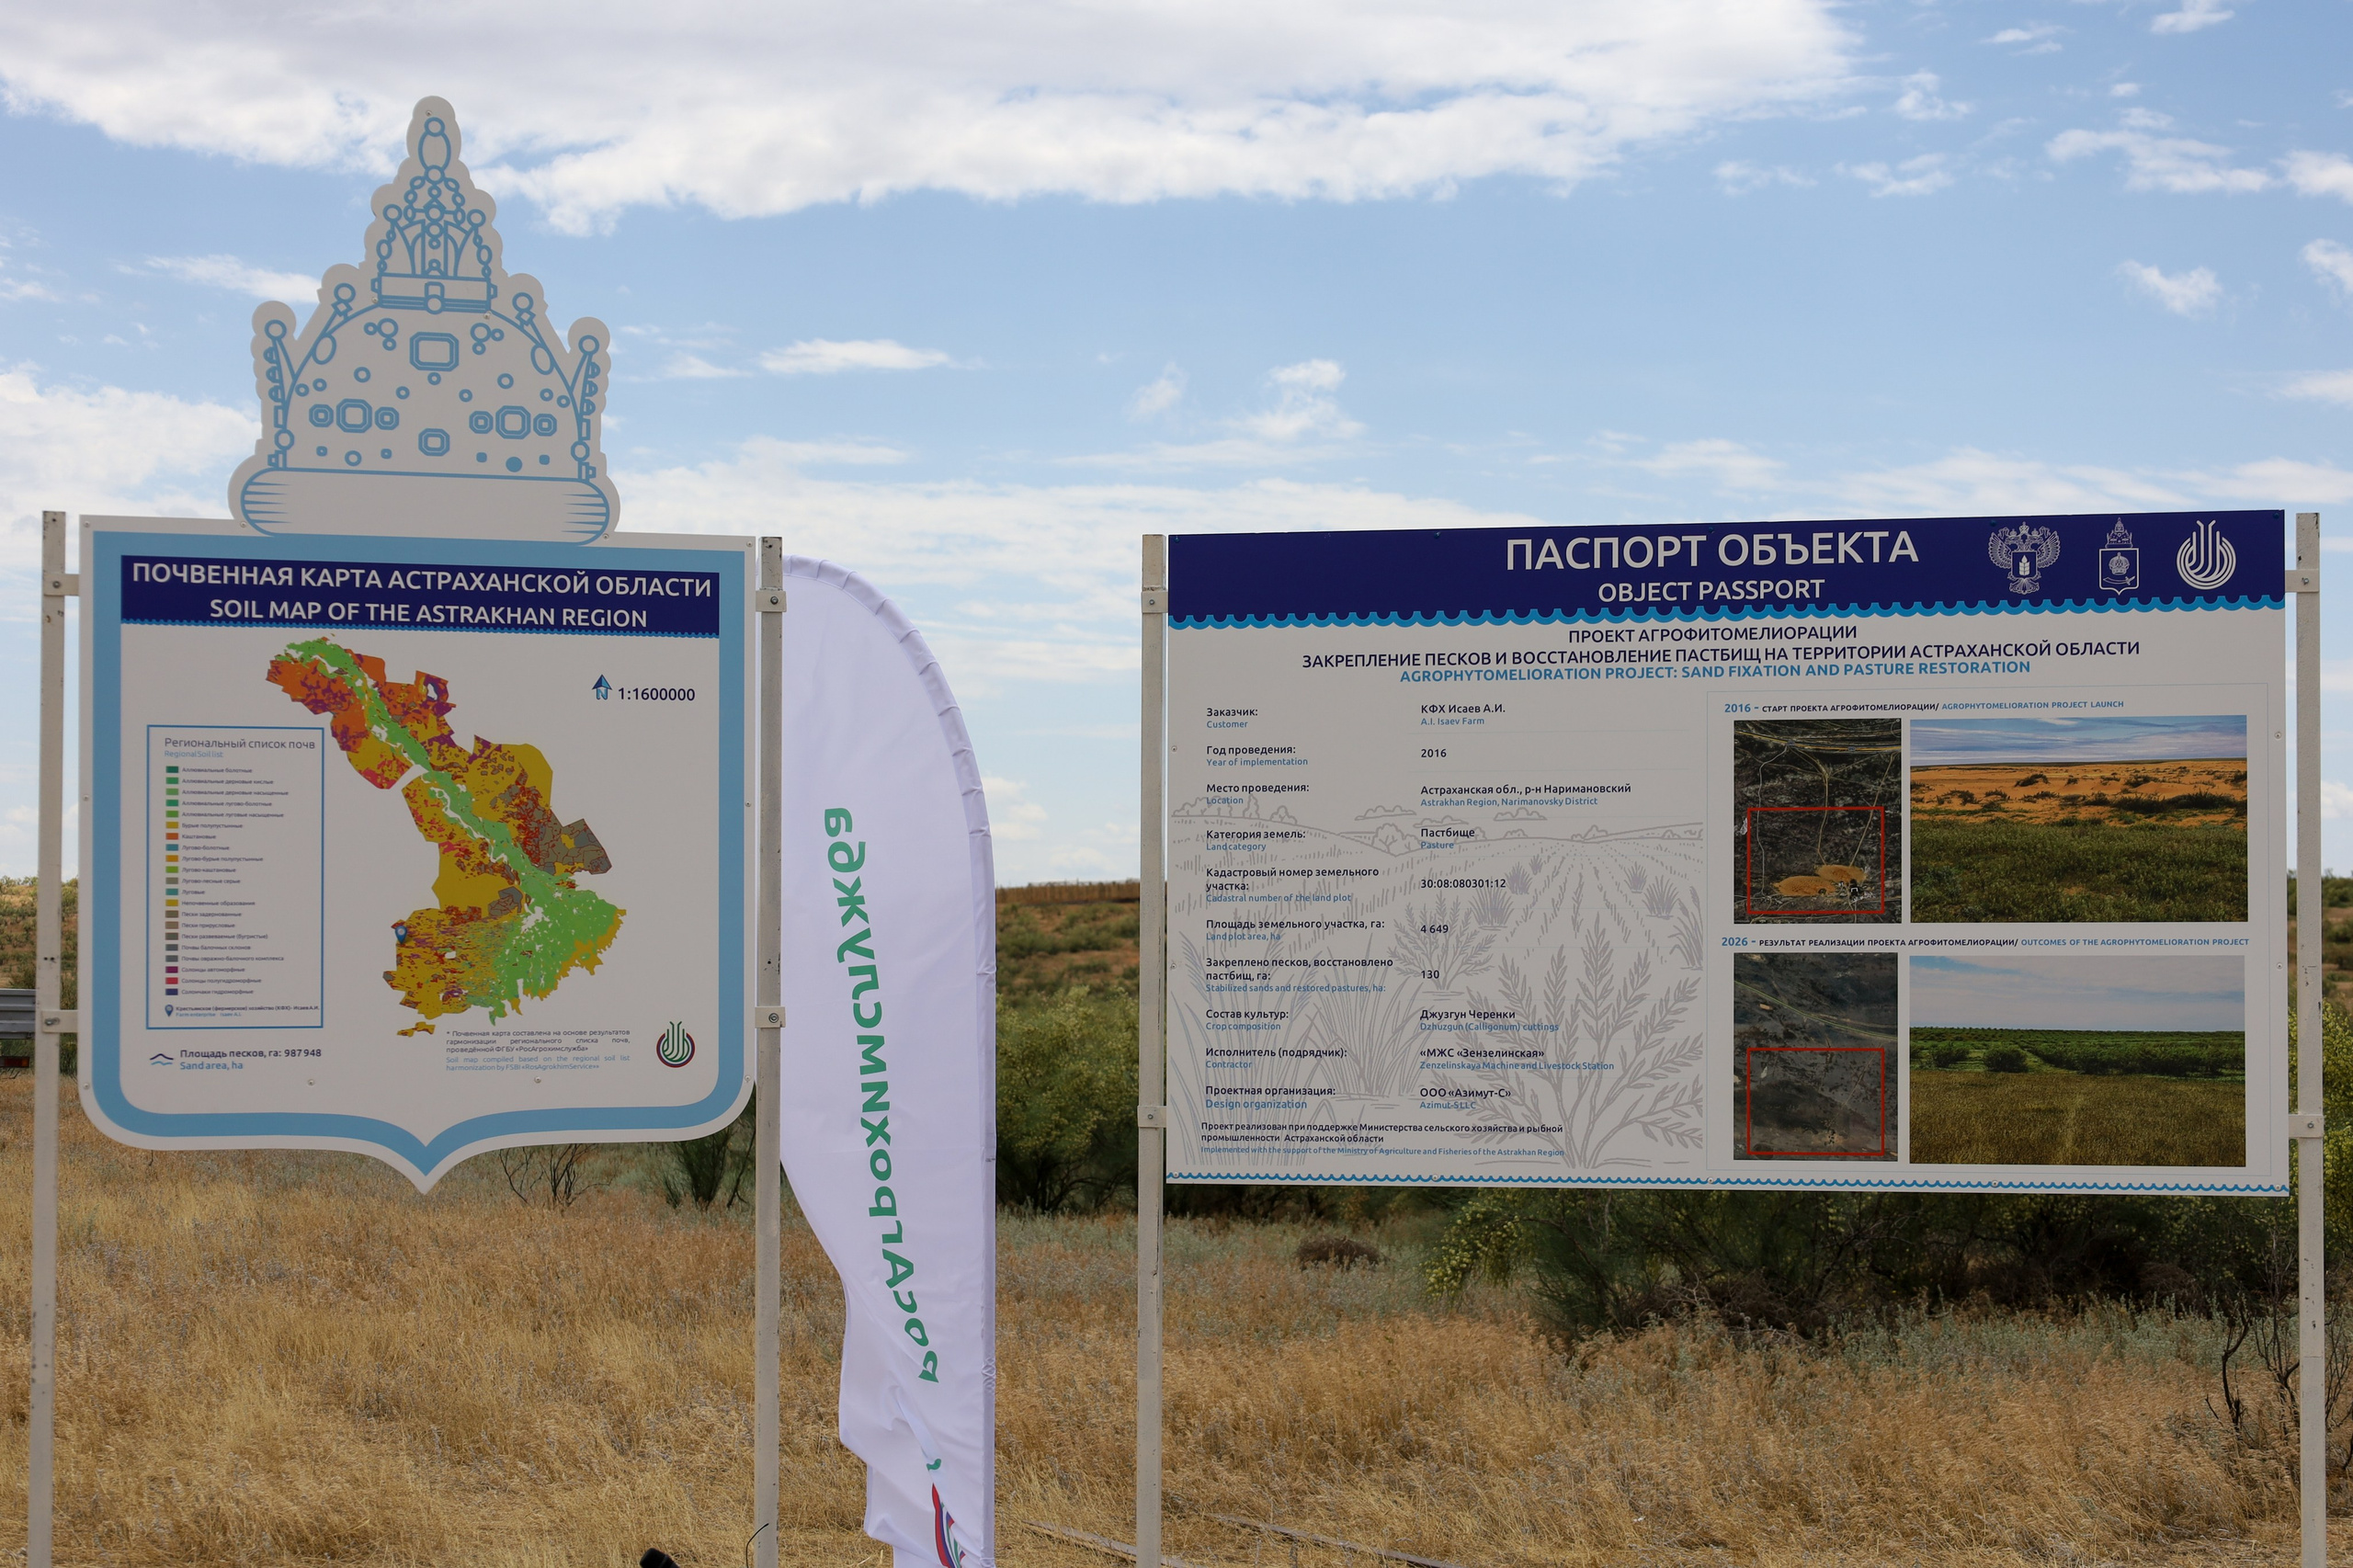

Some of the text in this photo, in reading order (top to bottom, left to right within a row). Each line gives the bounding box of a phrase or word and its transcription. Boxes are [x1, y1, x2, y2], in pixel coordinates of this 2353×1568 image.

[1507, 530, 1919, 571] ПАСПОРТ ОБЪЕКТА
[133, 562, 710, 597] ПОЧВЕННАЯ КАРТА АСТРАХАНСКОЙ ОБЛАСТИ
[1598, 579, 1825, 603] OBJECT PASSPORT
[210, 599, 647, 628] SOIL MAP OF THE ASTRAKHAN REGION
[1569, 625, 1857, 643] ПРОЕКТ АГРОФИТОМЕЛИОРАЦИИ
[1302, 640, 2140, 668] ЗАКРЕПЛЕНИЕ ПЕСКОВ И ВОССТАНОВЛЕНИЕ ПАСТБИЩ НА ТЕРРИТОРИИ АСТРАХАНСКОЙ ОБЛАСТИ
[1400, 661, 2030, 683] AGROPHYTOMELIORATION PROJECT: SAND FIXATION AND PASTURE RESTORATION
[619, 687, 696, 701] 1:1600000
[1421, 703, 1506, 714] КФХ Исаев А.И.
[1724, 703, 1751, 713] 2016
[1762, 705, 1788, 713] СТАРТ
[1830, 703, 1939, 711] АГРОФИТОМЕЛИОРАЦИИ/
[1941, 701, 2049, 711] AGROPHYTOMELIORATION
[2090, 700, 2124, 709] LAUNCH
[1206, 708, 1258, 717] Заказчик:
[1206, 720, 1248, 729] Customer
[1420, 717, 1485, 726] A.I. Isaev Farm
[165, 737, 315, 749] Региональный список почв
[164, 750, 198, 759] Regional
[197, 750, 211, 758] Soil
[1207, 745, 1296, 756] Год проведения:
[1421, 748, 1447, 758] 2016
[1206, 757, 1309, 767] Year of implementation
[1206, 784, 1310, 795] Место проведения:
[1420, 783, 1631, 797] Астраханская обл., р-н Наримановский
[1206, 796, 1244, 805] Location
[1420, 797, 1598, 808] Astrakhan Region, Narimanovsky District
[1206, 830, 1306, 841] Категория земель:
[1421, 827, 1475, 839] Пастбище
[1206, 842, 1267, 852] Land category
[1420, 841, 1455, 849] Pasture
[1206, 867, 1380, 879] Кадастровый номер земельного
[1206, 882, 1249, 893] участка:
[1421, 879, 1506, 889] 30:08:080301:12
[1206, 919, 1256, 930] Площадь
[1258, 921, 1323, 929] земельного
[1324, 921, 1368, 930] участка,
[1420, 924, 1449, 934] 4 649
[1206, 931, 1281, 943] Land plot area, ha
[1722, 937, 1748, 947] 2026
[1809, 939, 1865, 948] РЕАЛИЗАЦИИ
[1908, 938, 2018, 948] АГРОФИТОМЕЛИОРАЦИИ/
[1206, 958, 1269, 969] Закреплено
[1271, 960, 1312, 969] песков,
[1206, 971, 1271, 982] пастбищ, га:
[1421, 970, 1440, 980] 130
[1206, 1009, 1289, 1021] Состав культур:
[1419, 1009, 1516, 1021] Джузгун Черенки
[1206, 1022, 1281, 1032] Crop composition
[180, 1050, 228, 1059] Площадь
[284, 1049, 302, 1058] 987
[303, 1049, 322, 1058] 948
[1206, 1047, 1347, 1059] Исполнитель (подрядчик):
[1420, 1048, 1545, 1058] «МЖС «Зензелинская»
[179, 1061, 244, 1071] Sand area, ha
[1205, 1060, 1253, 1069] Contractor
[1206, 1085, 1336, 1097] Проектная организация:
[1420, 1087, 1511, 1100] ООО «Азимут-С»
[1205, 1098, 1307, 1111] Design organization
[1419, 1100, 1477, 1110] Azimut-S LLC
[1201, 1133, 1384, 1144] промышленности Астраханской области
